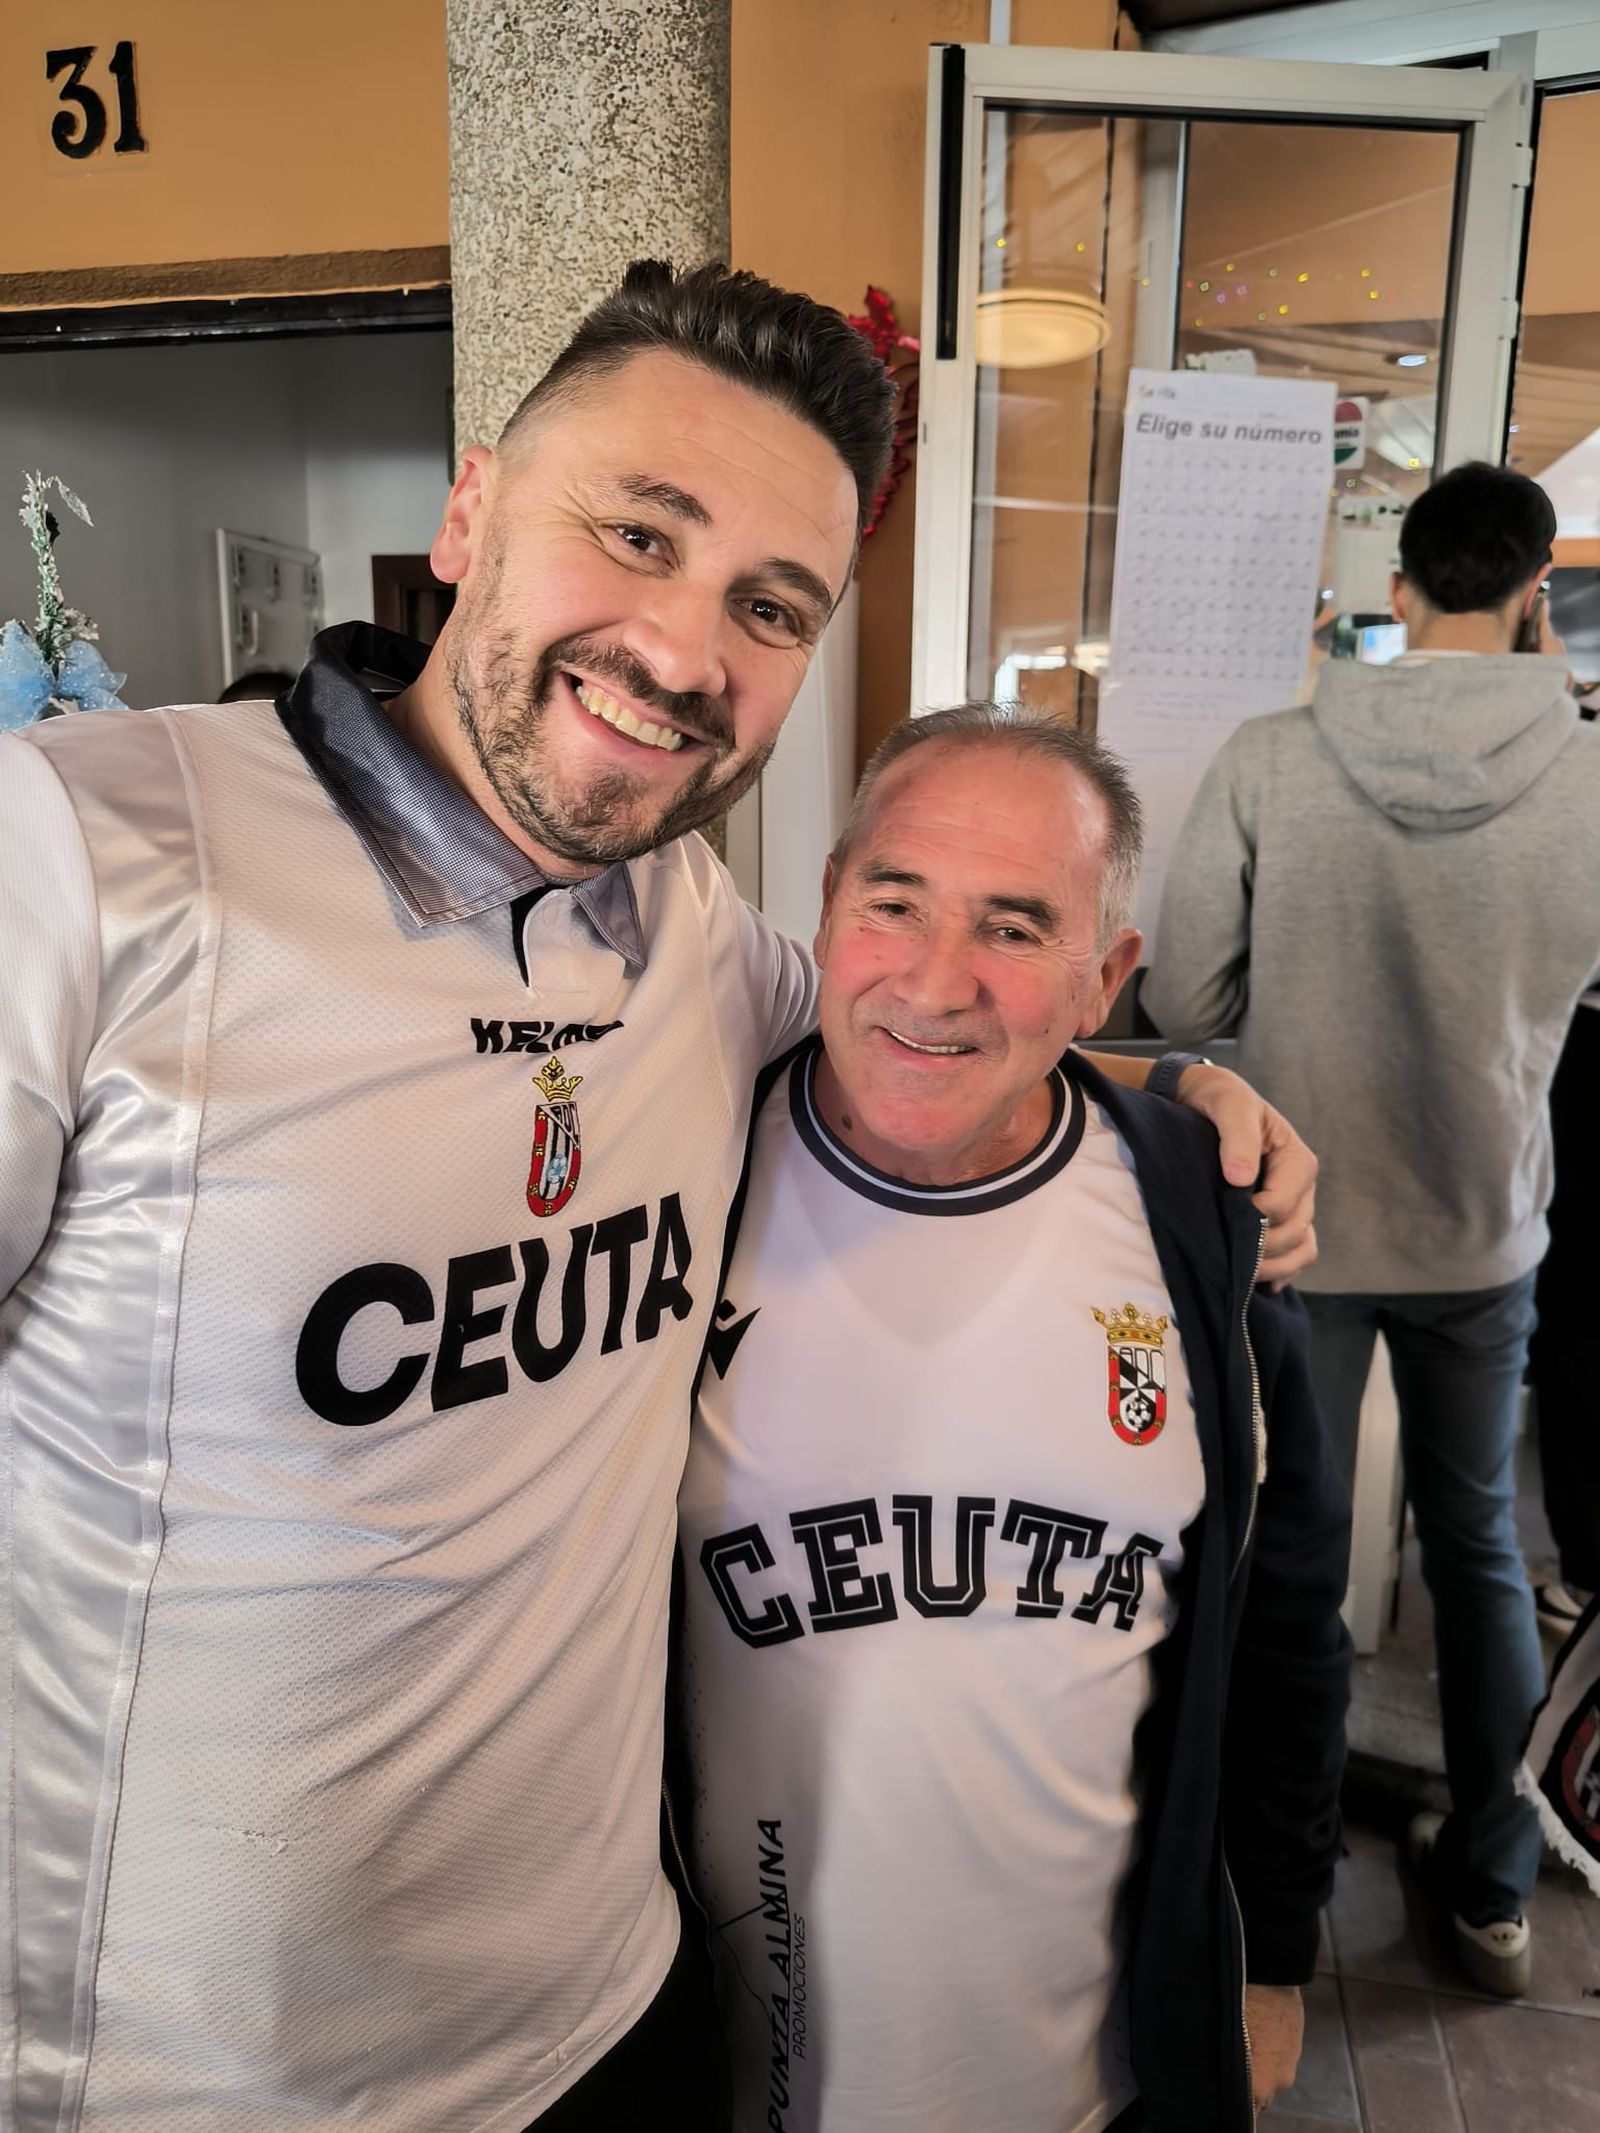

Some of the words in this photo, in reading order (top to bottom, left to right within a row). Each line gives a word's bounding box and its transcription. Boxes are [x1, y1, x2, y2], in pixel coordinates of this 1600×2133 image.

[45, 40, 147, 160] 31
[1135, 412, 1193, 440] Elige
[1199, 422, 1228, 440] su
[1233, 423, 1323, 445] número
[295, 1192, 693, 1426] CEUTA
[700, 1494, 1164, 1650] CEUTA
[756, 1818, 791, 1984] ALMINA
[792, 1912, 808, 2061] PROMOCIONES
[767, 1993, 791, 2133] PUNTA
